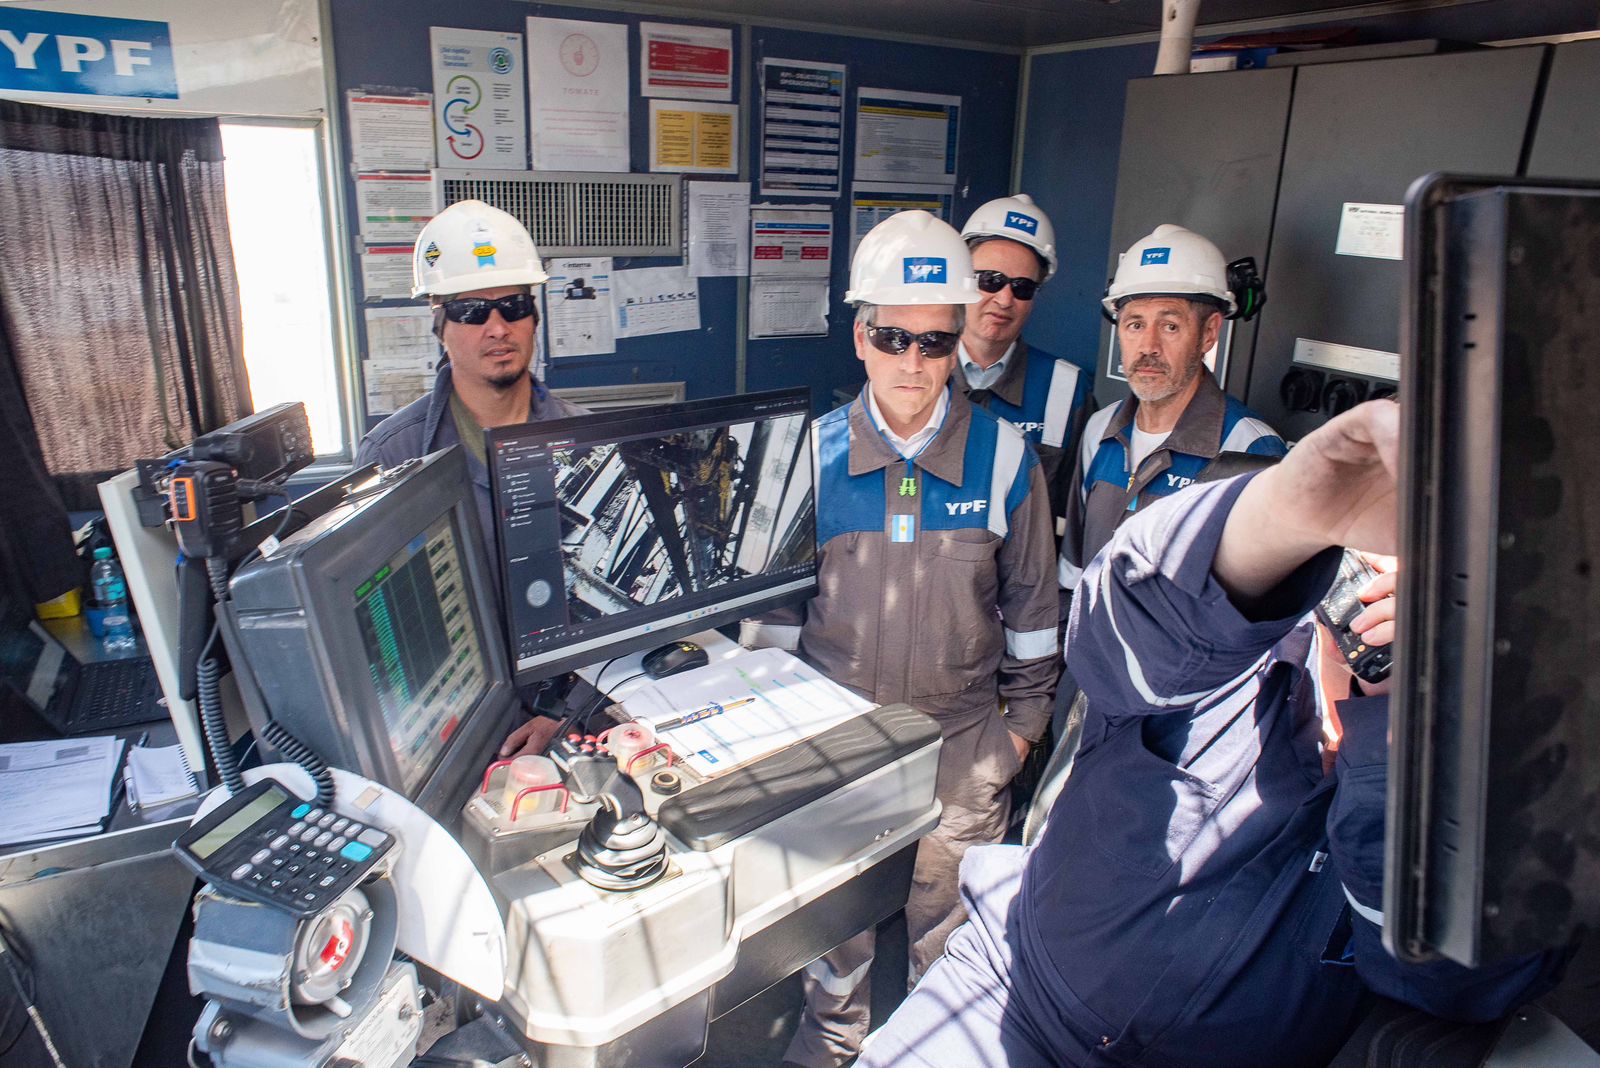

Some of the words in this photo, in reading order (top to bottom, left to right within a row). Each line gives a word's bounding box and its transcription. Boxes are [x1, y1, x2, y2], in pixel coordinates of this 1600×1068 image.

[0, 30, 152, 76] YPF
[563, 88, 601, 96] TOMATE
[1010, 216, 1036, 228] YPF
[908, 265, 943, 275] YPF
[1167, 474, 1196, 489] YP
[945, 500, 987, 515] YPF
